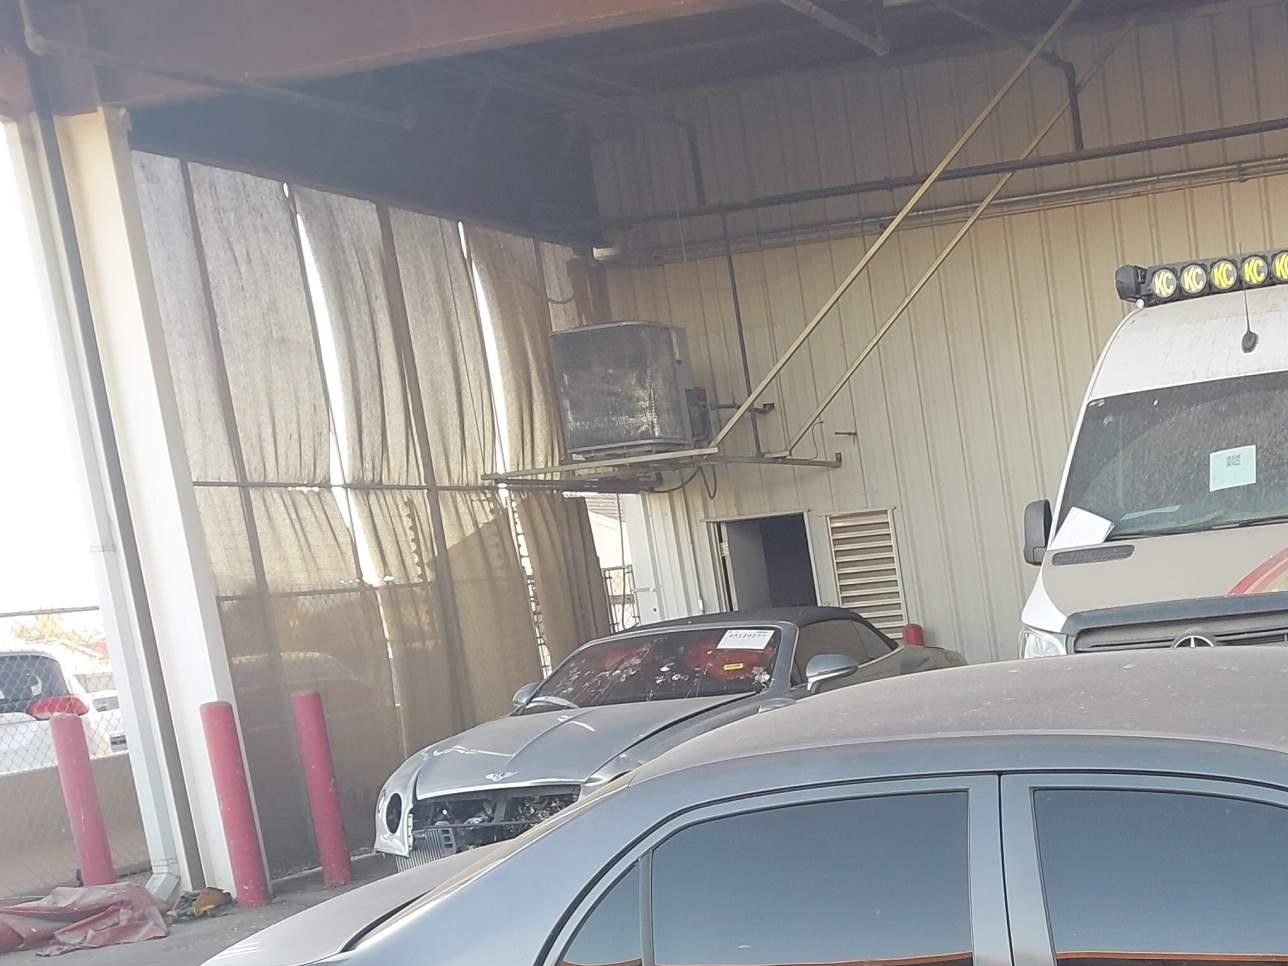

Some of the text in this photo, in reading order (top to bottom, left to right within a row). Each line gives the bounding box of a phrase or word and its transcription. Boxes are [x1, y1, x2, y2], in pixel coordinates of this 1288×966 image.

[1154, 270, 1174, 297] KC
[1183, 266, 1204, 292] KC
[1213, 262, 1234, 288] KC
[1244, 258, 1264, 284] KC
